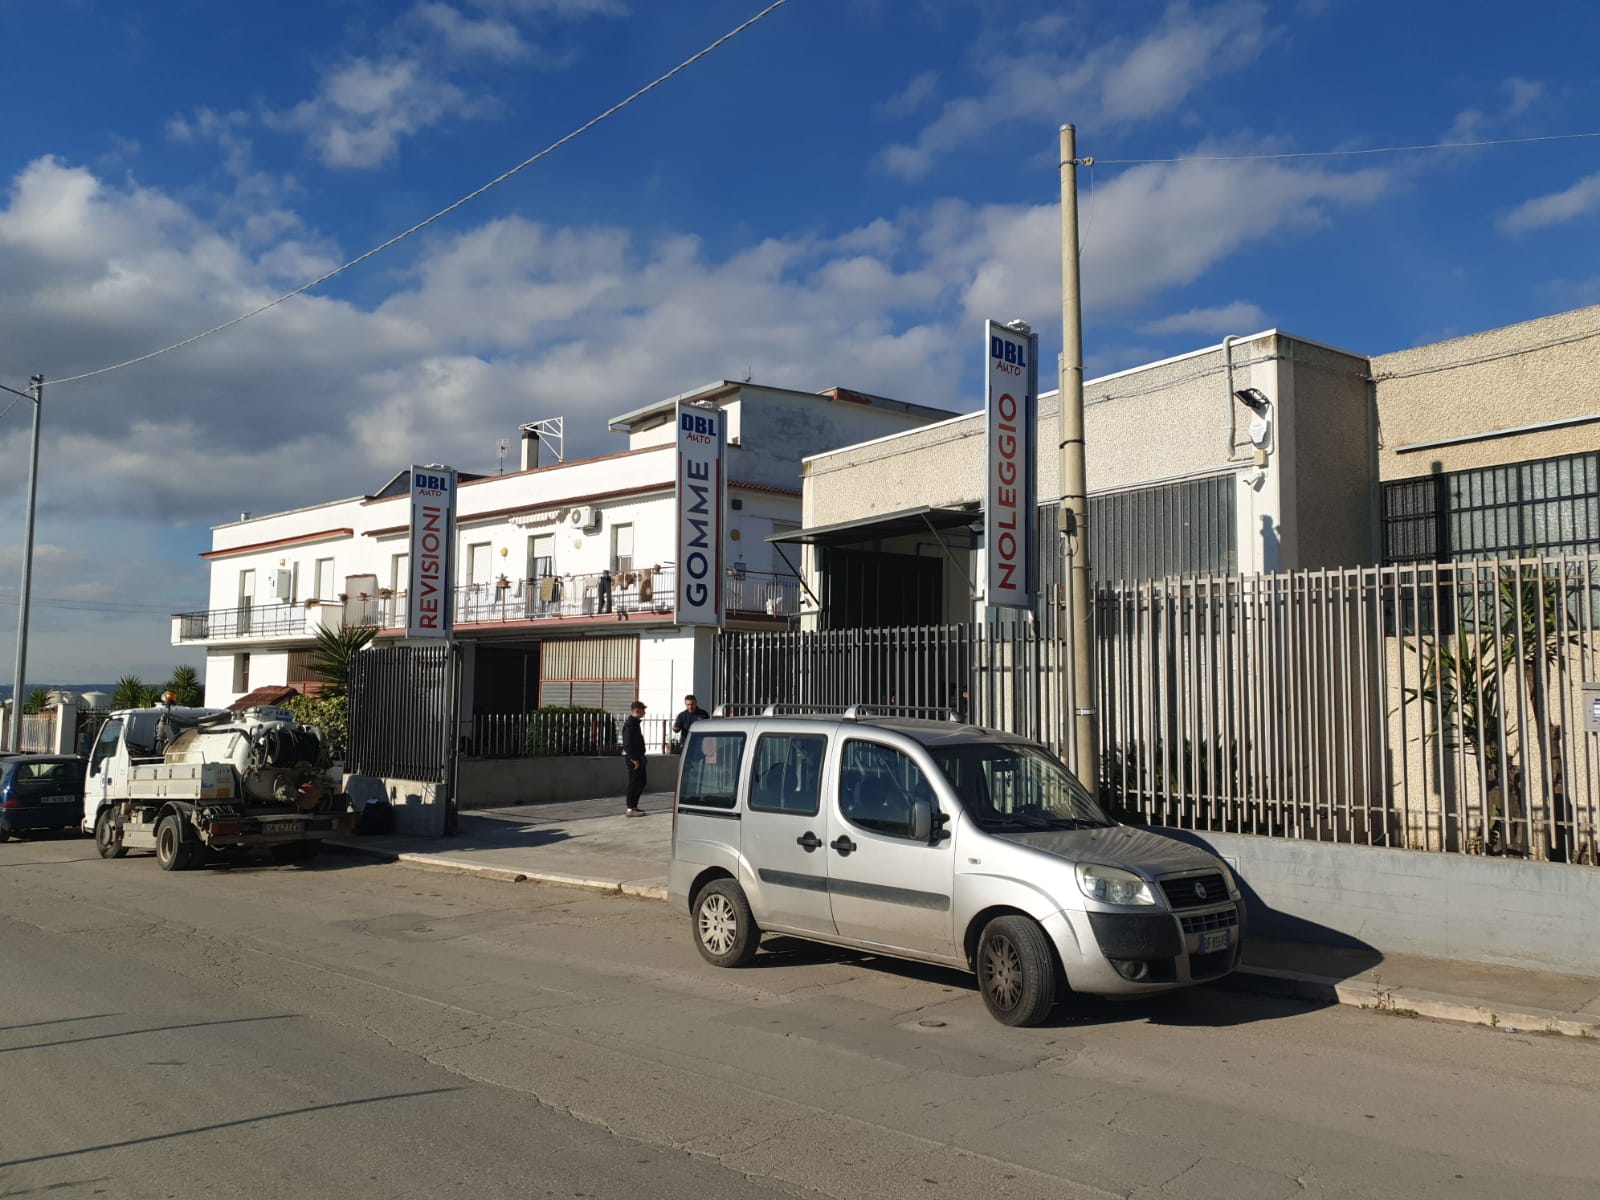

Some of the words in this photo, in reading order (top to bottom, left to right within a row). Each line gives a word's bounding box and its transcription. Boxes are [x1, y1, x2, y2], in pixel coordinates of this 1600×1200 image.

[991, 335, 1026, 368] DBL
[996, 360, 1021, 377] AUTO
[681, 412, 717, 437] DBL
[686, 432, 711, 445] AUTO
[415, 473, 448, 492] DBL
[418, 489, 442, 497] AUTO
[998, 393, 1017, 591] NOLEGGIO
[686, 459, 709, 608] GOMME
[419, 506, 441, 629] REVISIONI
